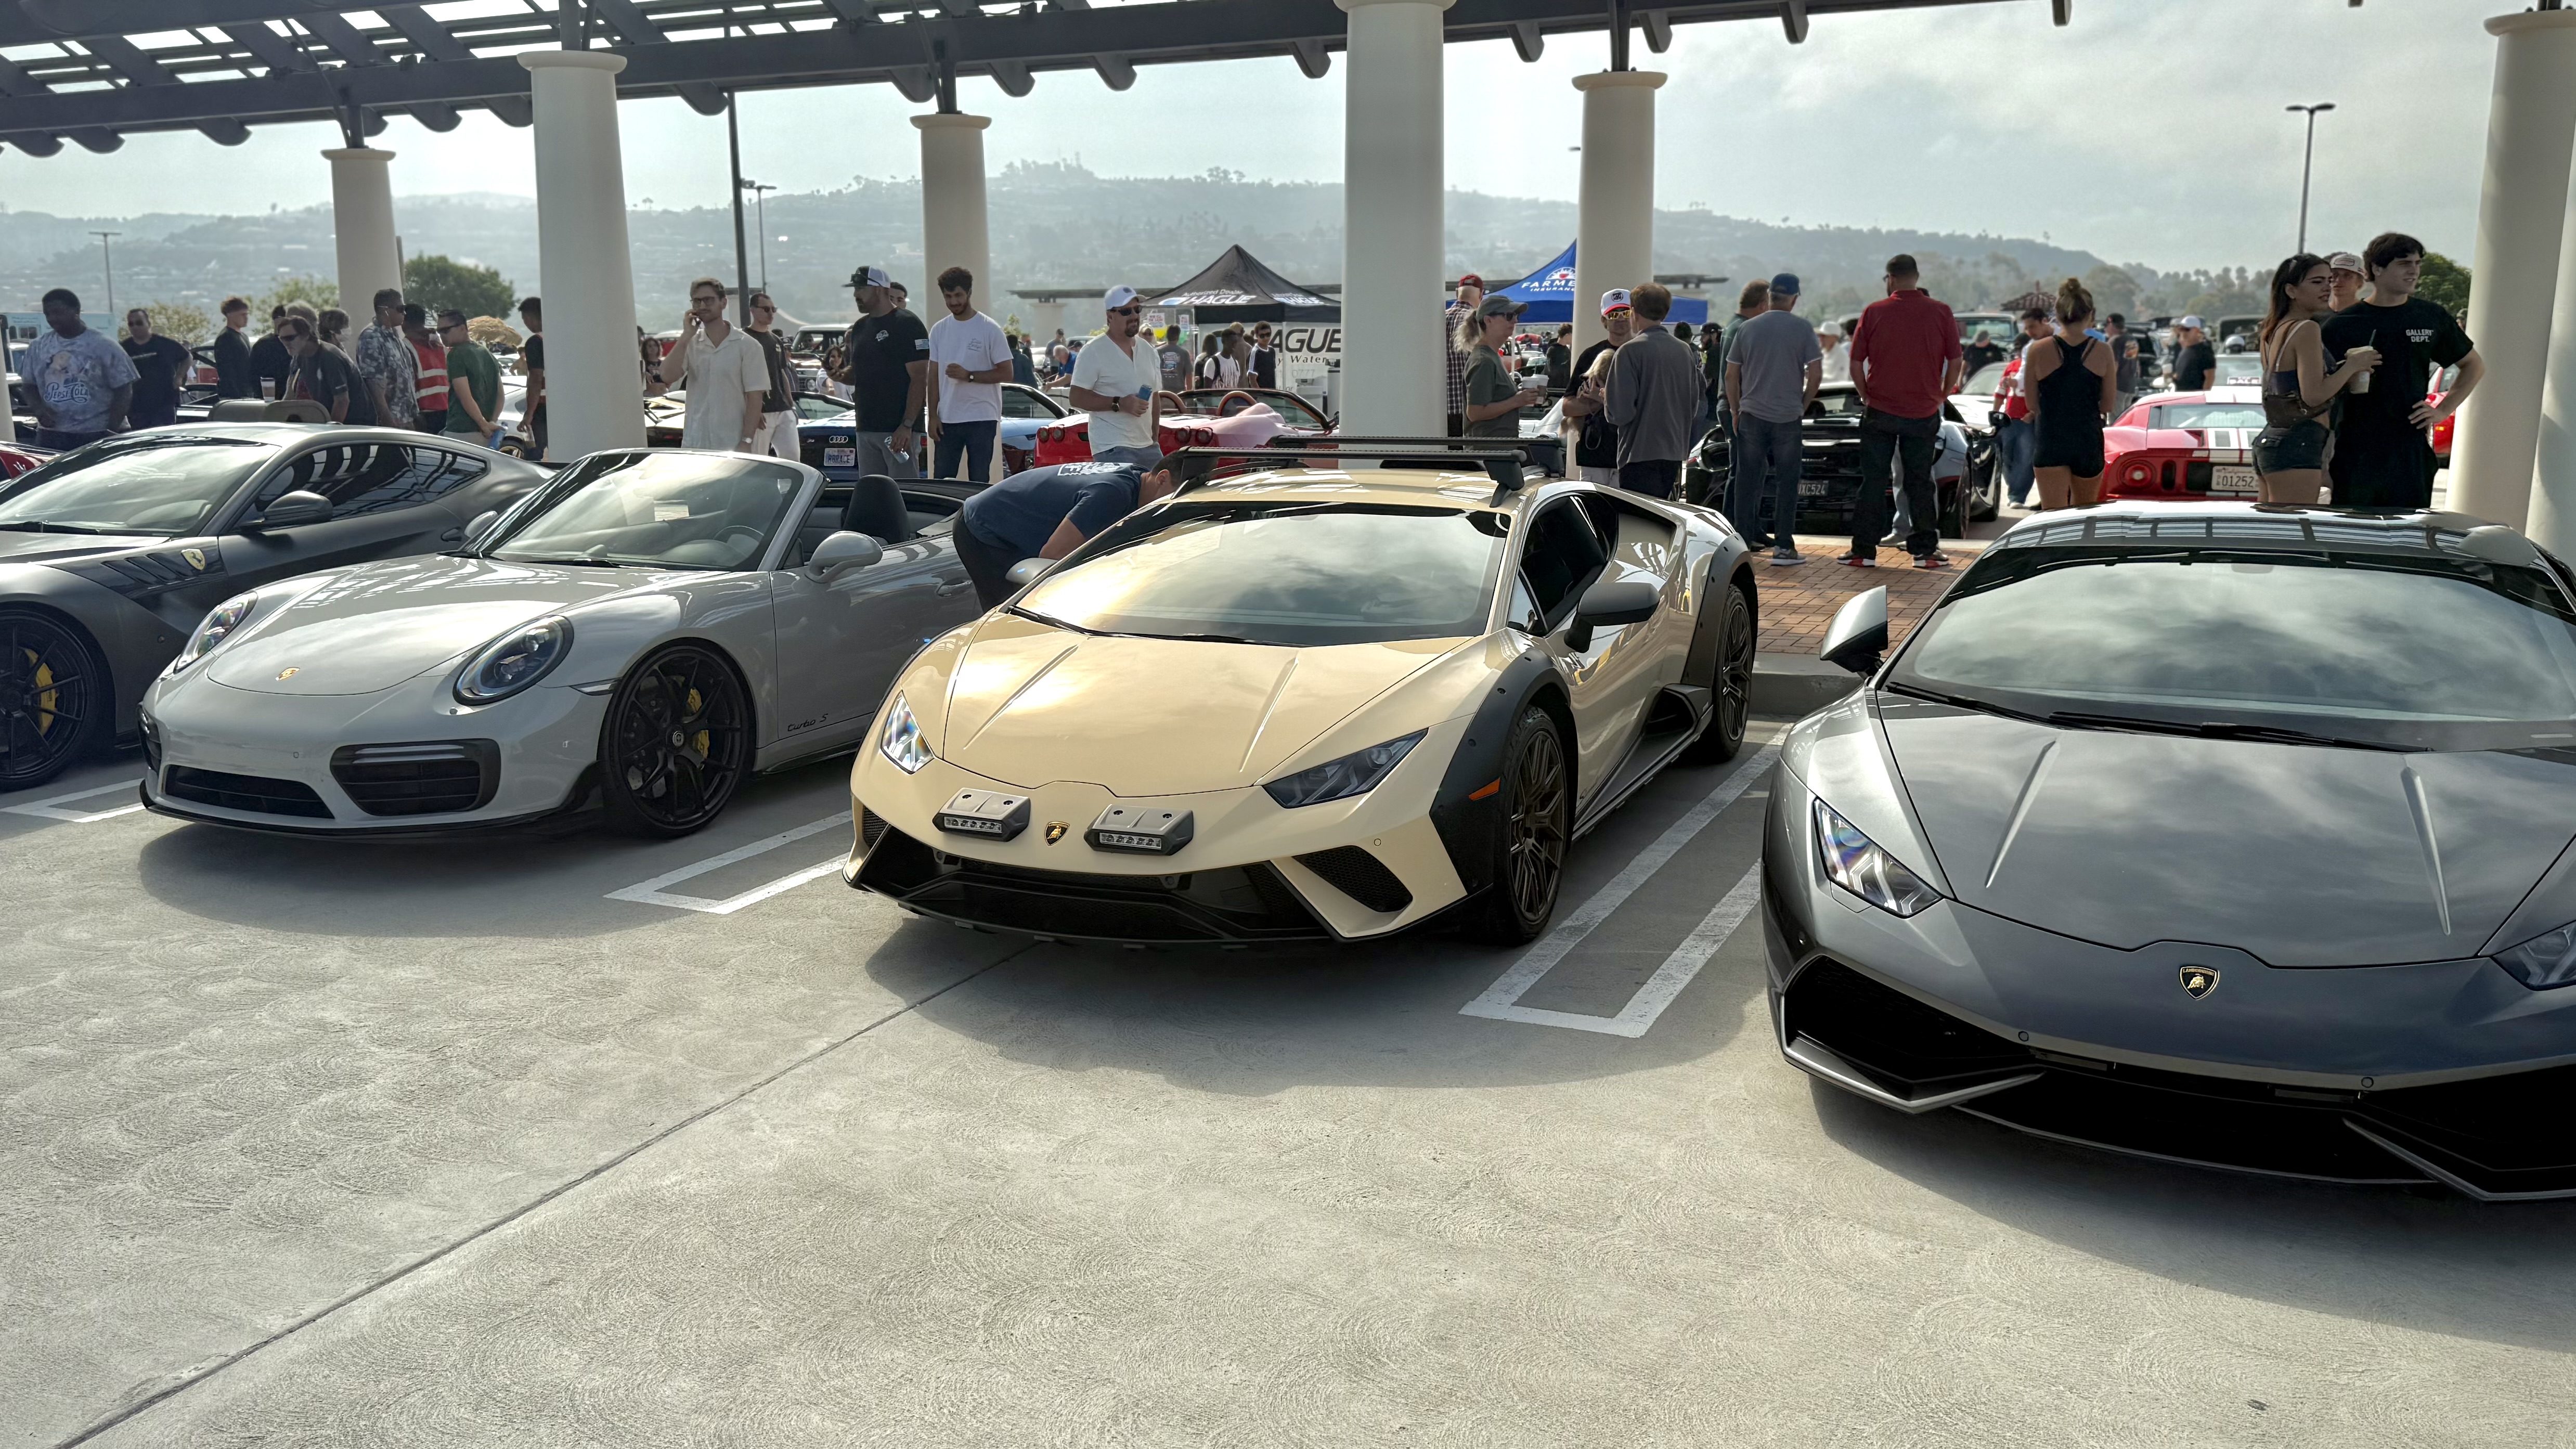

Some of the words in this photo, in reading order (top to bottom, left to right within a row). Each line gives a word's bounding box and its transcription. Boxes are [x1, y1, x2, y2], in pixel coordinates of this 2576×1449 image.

[1521, 280, 1575, 288] FARME
[1187, 294, 1257, 304] HAGUE
[1268, 328, 1341, 354] AGUE
[1291, 355, 1327, 363] Water
[2222, 475, 2254, 487] 01252
